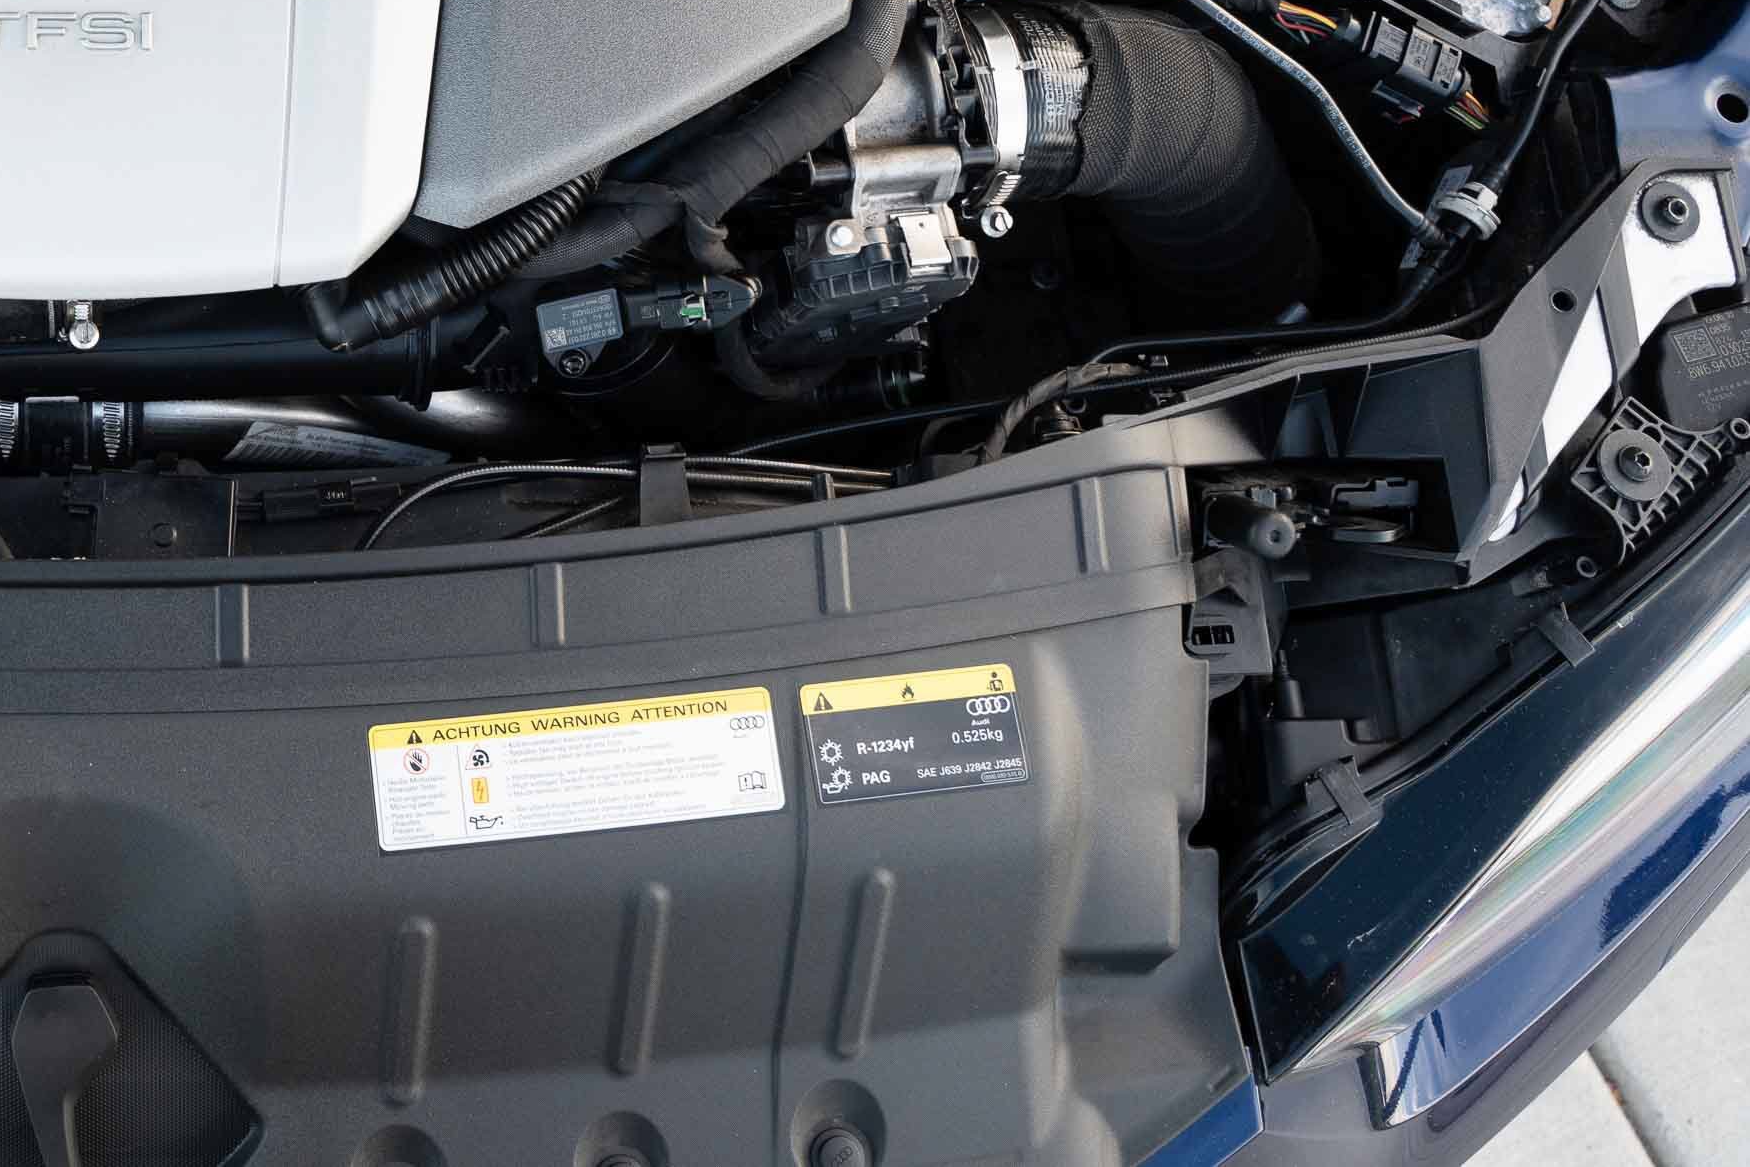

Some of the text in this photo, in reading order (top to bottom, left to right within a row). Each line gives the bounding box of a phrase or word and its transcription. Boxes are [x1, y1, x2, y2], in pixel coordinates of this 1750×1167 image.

[433, 699, 729, 742] ACHTUNG WARNING ATTENTION
[971, 718, 991, 727] Audi
[856, 729, 1004, 755] R-1234yf 0.525kg
[861, 769, 892, 785] PAG
[916, 767, 937, 779] SAE
[939, 764, 963, 776] J639
[964, 761, 993, 773] J2842
